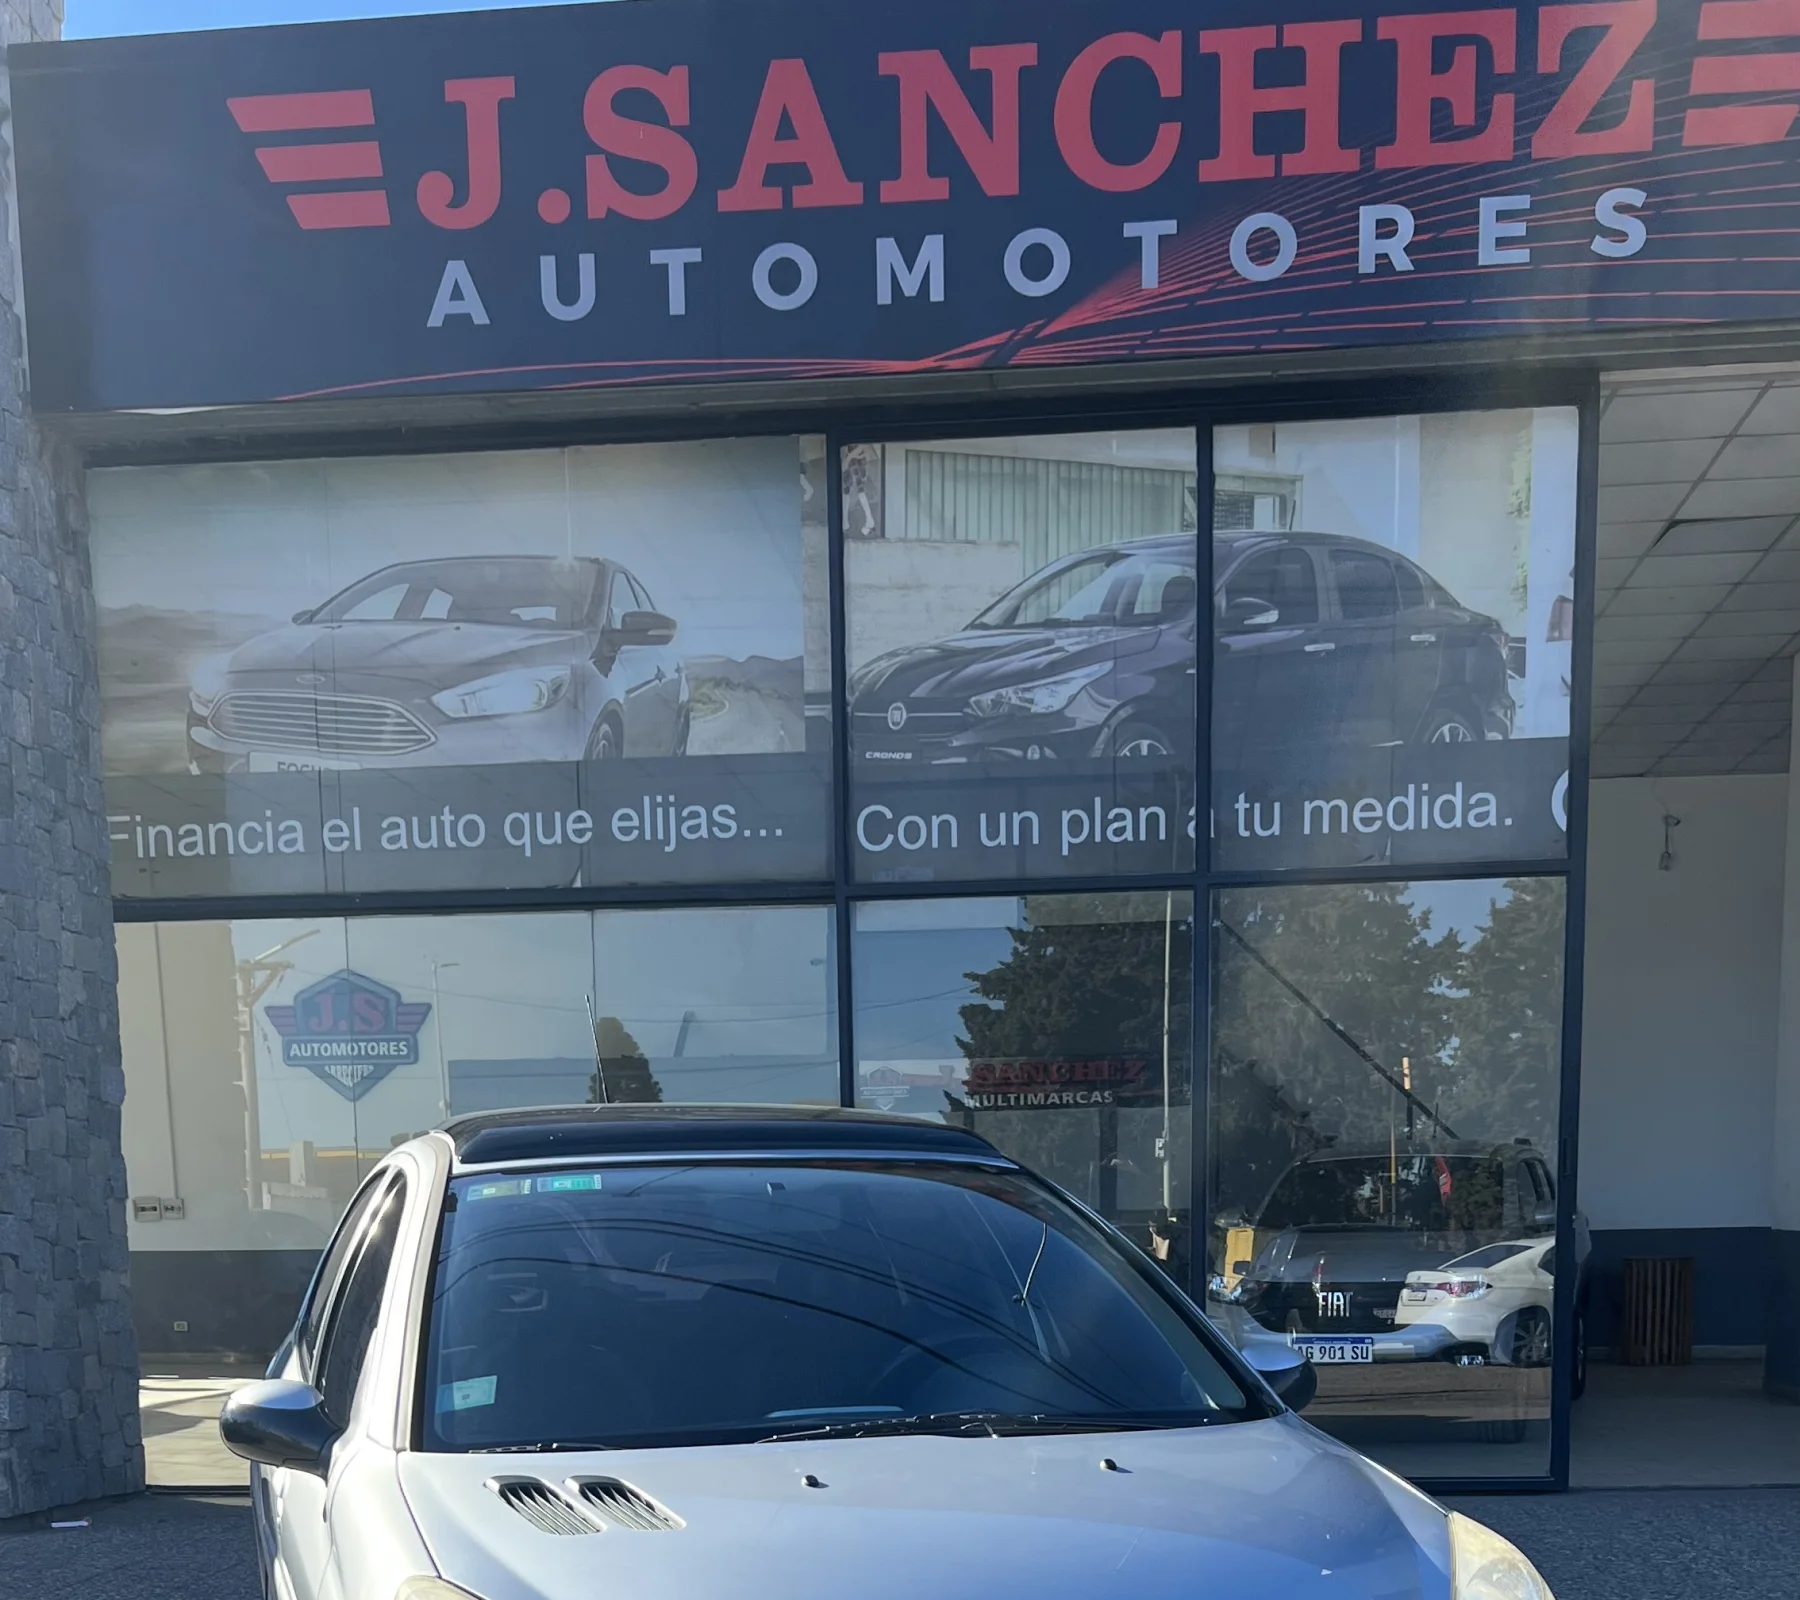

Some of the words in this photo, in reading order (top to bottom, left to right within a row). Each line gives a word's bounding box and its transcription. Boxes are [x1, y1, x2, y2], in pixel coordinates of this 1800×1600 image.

[416, 0, 1658, 230] J.SANCHEZ
[427, 187, 1648, 328] AUTOMOTORES
[106, 809, 305, 858] Financia
[322, 806, 362, 853] el
[380, 804, 487, 851] auto
[503, 807, 594, 857] que
[610, 795, 785, 852] elijas...
[856, 802, 959, 853] Con
[979, 806, 1041, 847] un
[1060, 797, 1167, 855] plan
[1234, 792, 1282, 838] tu
[1304, 781, 1513, 834] medida.
[289, 1041, 409, 1058] AUTOMOTORES
[1318, 1291, 1353, 1318] FIAT
[1319, 1345, 1346, 1361] 901
[1351, 1345, 1370, 1361] SU
